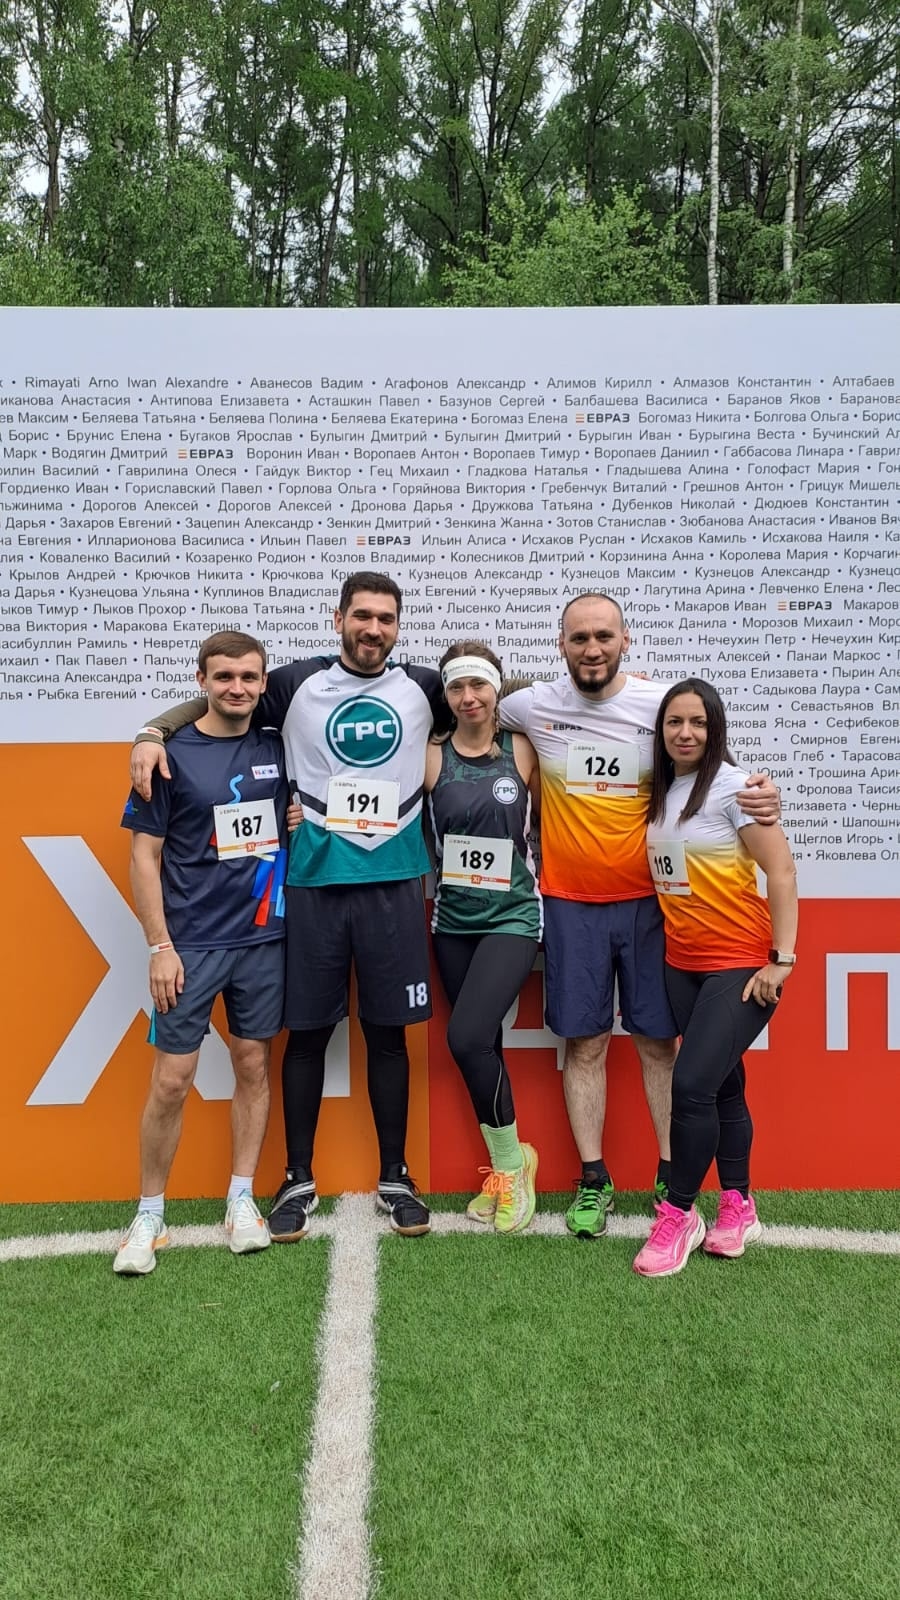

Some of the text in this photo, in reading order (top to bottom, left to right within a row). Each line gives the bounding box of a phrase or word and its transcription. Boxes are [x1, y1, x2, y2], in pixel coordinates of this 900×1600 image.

[25, 376, 894, 392] Rimayati Arno Iwan Alexandre Аванесов Вадим Агафонов Александр Алимов Кирилл Алмазов Константин Алтабаев
[18, 410, 849, 426] Максим Беляева Татьяна Беляева Полина Беляева Екатерина Богомаз Елена ЕВРАЗ Богомаз Никита Болгова Ольга
[4, 445, 844, 462] Марк Водягин Дмитрий ЕВРАЗ Воронин Иван Воропаев Антон Воропаев Тимур Воропаев Даниил Габбасова Линара
[0, 480, 844, 496] Гордиенко Иван Гориславский Павел Горлова Ольга Горяйнова Виктория Гребенчук Виталий Грешнов Антон Грицук
[5, 514, 876, 531] Дарья Захаров Евгений Зацепин Александр Зенкин Дмитрий Зенкина Жанна Зотов Станислав Зюбанова Анастасия Иванов
[40, 548, 828, 566] Коваленко Василий Козаренко Родион Козлов Владимир Колесников Дмитрий Корзинина Анна Королева Мария
[14, 582, 864, 600] Дарья Кузнецова Ульяна Куплинов Владислав Евгений Кучерявых Александр Лагутина Арина Левченко Елена
[26, 616, 852, 634] Виктория Маракова Екатерина Маркосов Алиса Матынян Мисиюк Данила Морозов Михаил
[56, 650, 881, 666] Пак Павел Памятных Алексей Панаи Маркос
[64, 672, 142, 685] Александра
[511, 669, 559, 680] Михаил
[652, 668, 687, 679] Агата
[701, 668, 746, 682] Пухова
[751, 668, 819, 680] Елизавета
[832, 666, 874, 680] Пырин
[38, 684, 860, 700] Рыбка Евгений Садыкова Лаура
[791, 700, 874, 711] Севастьянов
[774, 717, 806, 728] Ясна
[734, 750, 824, 764] Тарасов Глеб
[585, 756, 620, 777] 126
[808, 767, 866, 780] Трошина
[796, 784, 852, 797] Фролова
[347, 793, 379, 814] 191
[781, 801, 846, 812] Елизавета
[232, 815, 262, 838] 187
[794, 833, 884, 846] Щеглов Игорь
[460, 850, 495, 870] 189
[816, 850, 876, 860] Яковлева
[654, 855, 673, 875] 118
[406, 982, 428, 1008] 18
